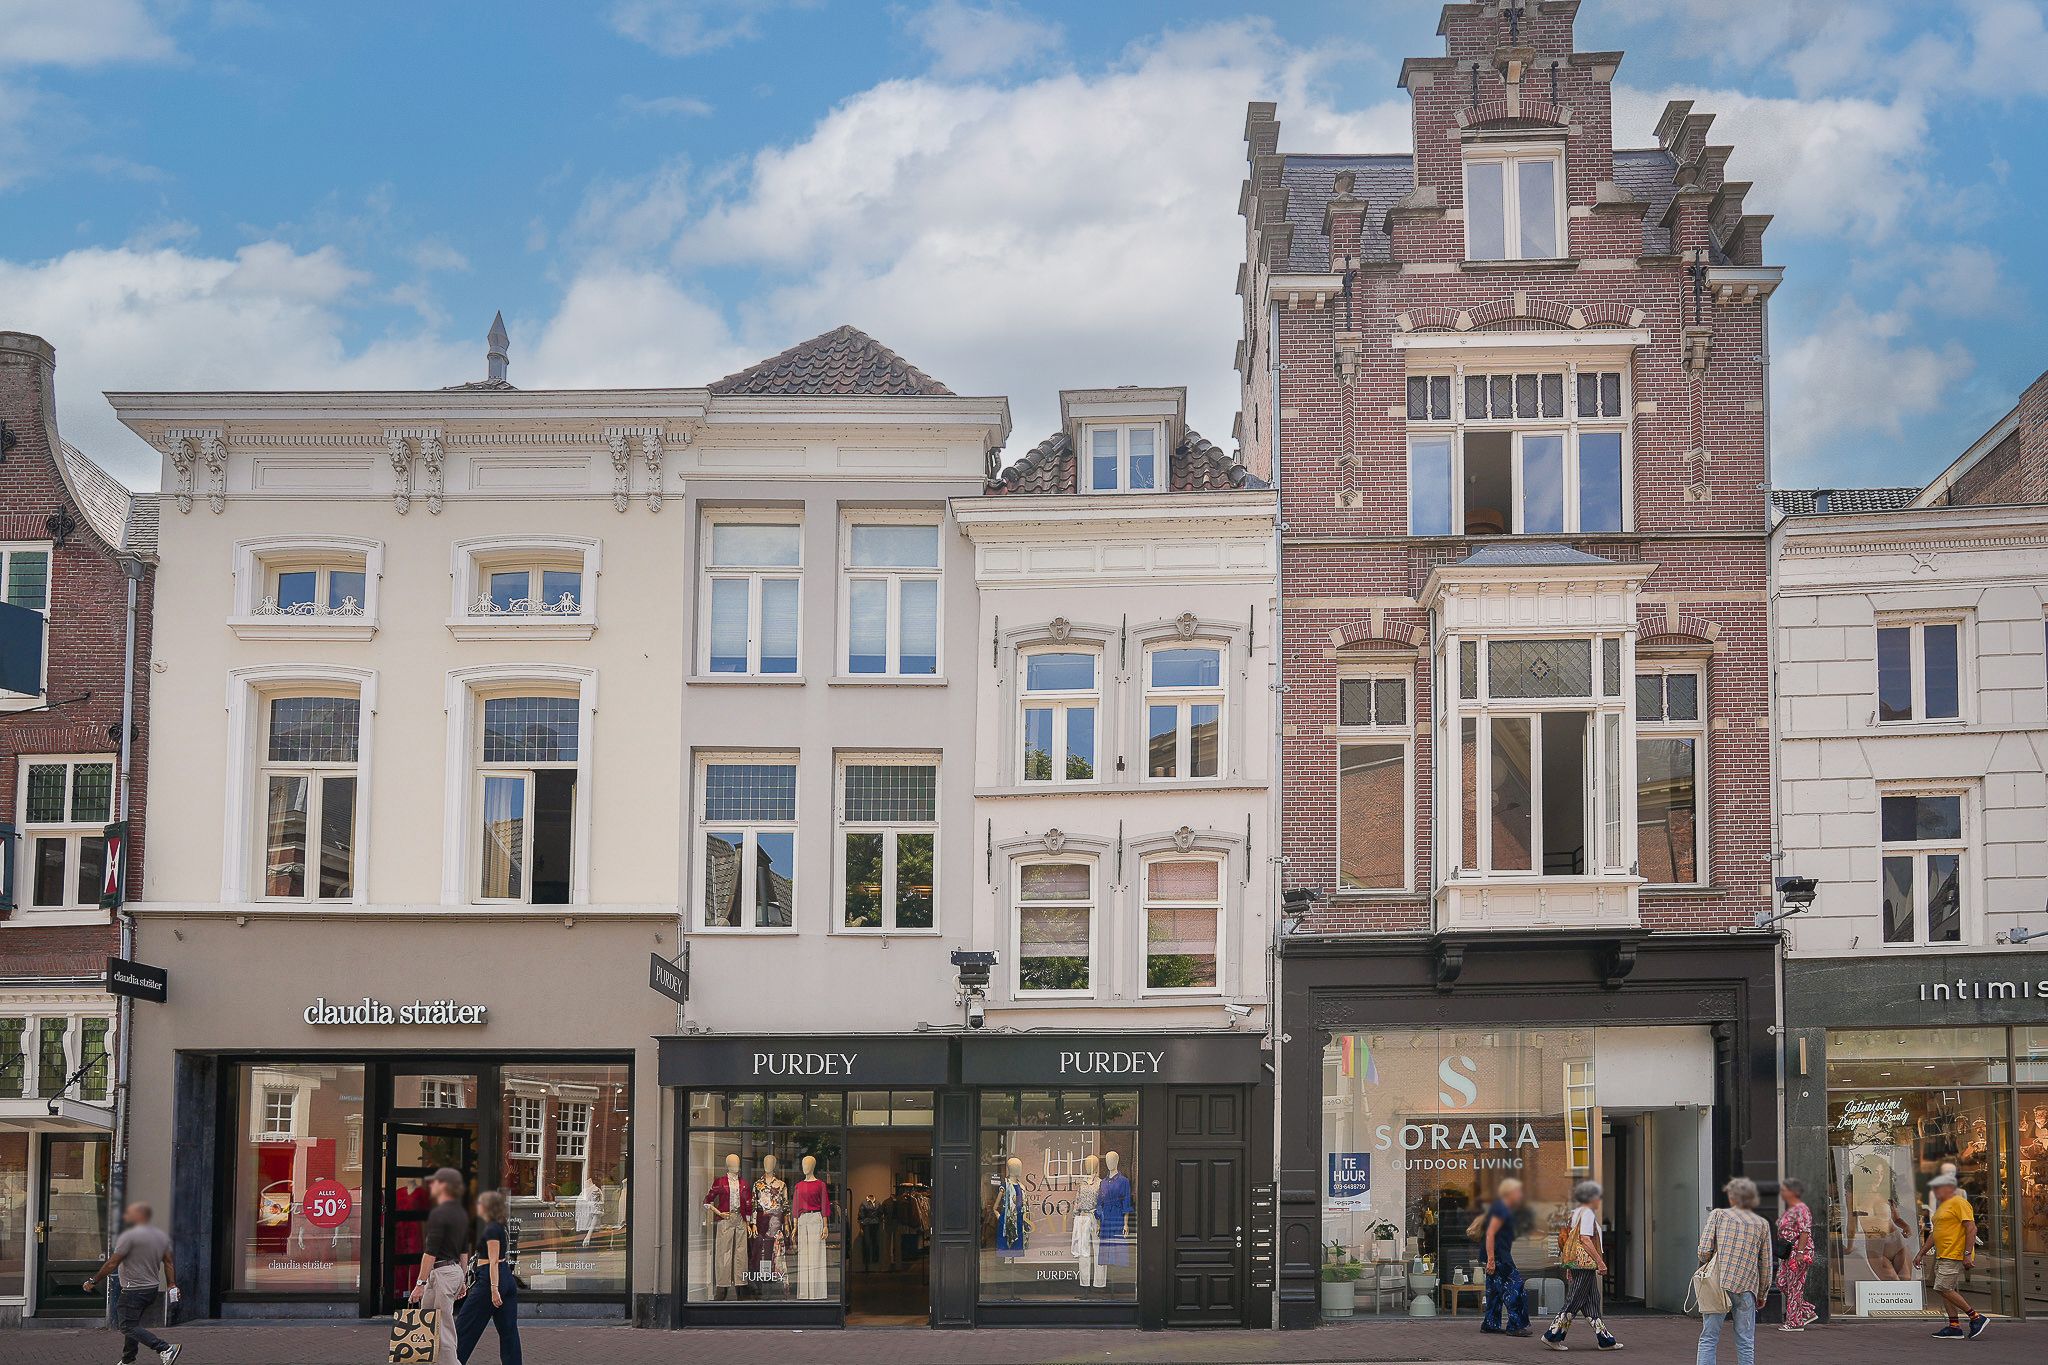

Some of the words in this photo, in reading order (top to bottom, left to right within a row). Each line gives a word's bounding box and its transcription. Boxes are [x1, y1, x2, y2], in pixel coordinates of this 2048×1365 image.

[114, 971, 139, 985] claudia
[140, 978, 163, 990] sträter
[656, 965, 683, 994] PURDEY
[303, 997, 395, 1025] claudia
[400, 999, 486, 1025] sträter
[753, 1053, 858, 1075] PURDEY
[1059, 1051, 1165, 1073] PURDEY
[1845, 1098, 1902, 1113] Intimissimi
[1375, 1123, 1539, 1150] SORARA
[1342, 1158, 1357, 1169] TE
[1391, 1159, 1468, 1170] OUTDOOR
[1473, 1158, 1523, 1169] LIVING
[1333, 1170, 1366, 1182] HUUR
[306, 1198, 347, 1217] -50%
[268, 1259, 300, 1270] claudia
[302, 1260, 334, 1270] sträter
[565, 1260, 596, 1270] sträter
[742, 1271, 785, 1282] PURDEY
[1036, 1270, 1080, 1280] PURDEY
